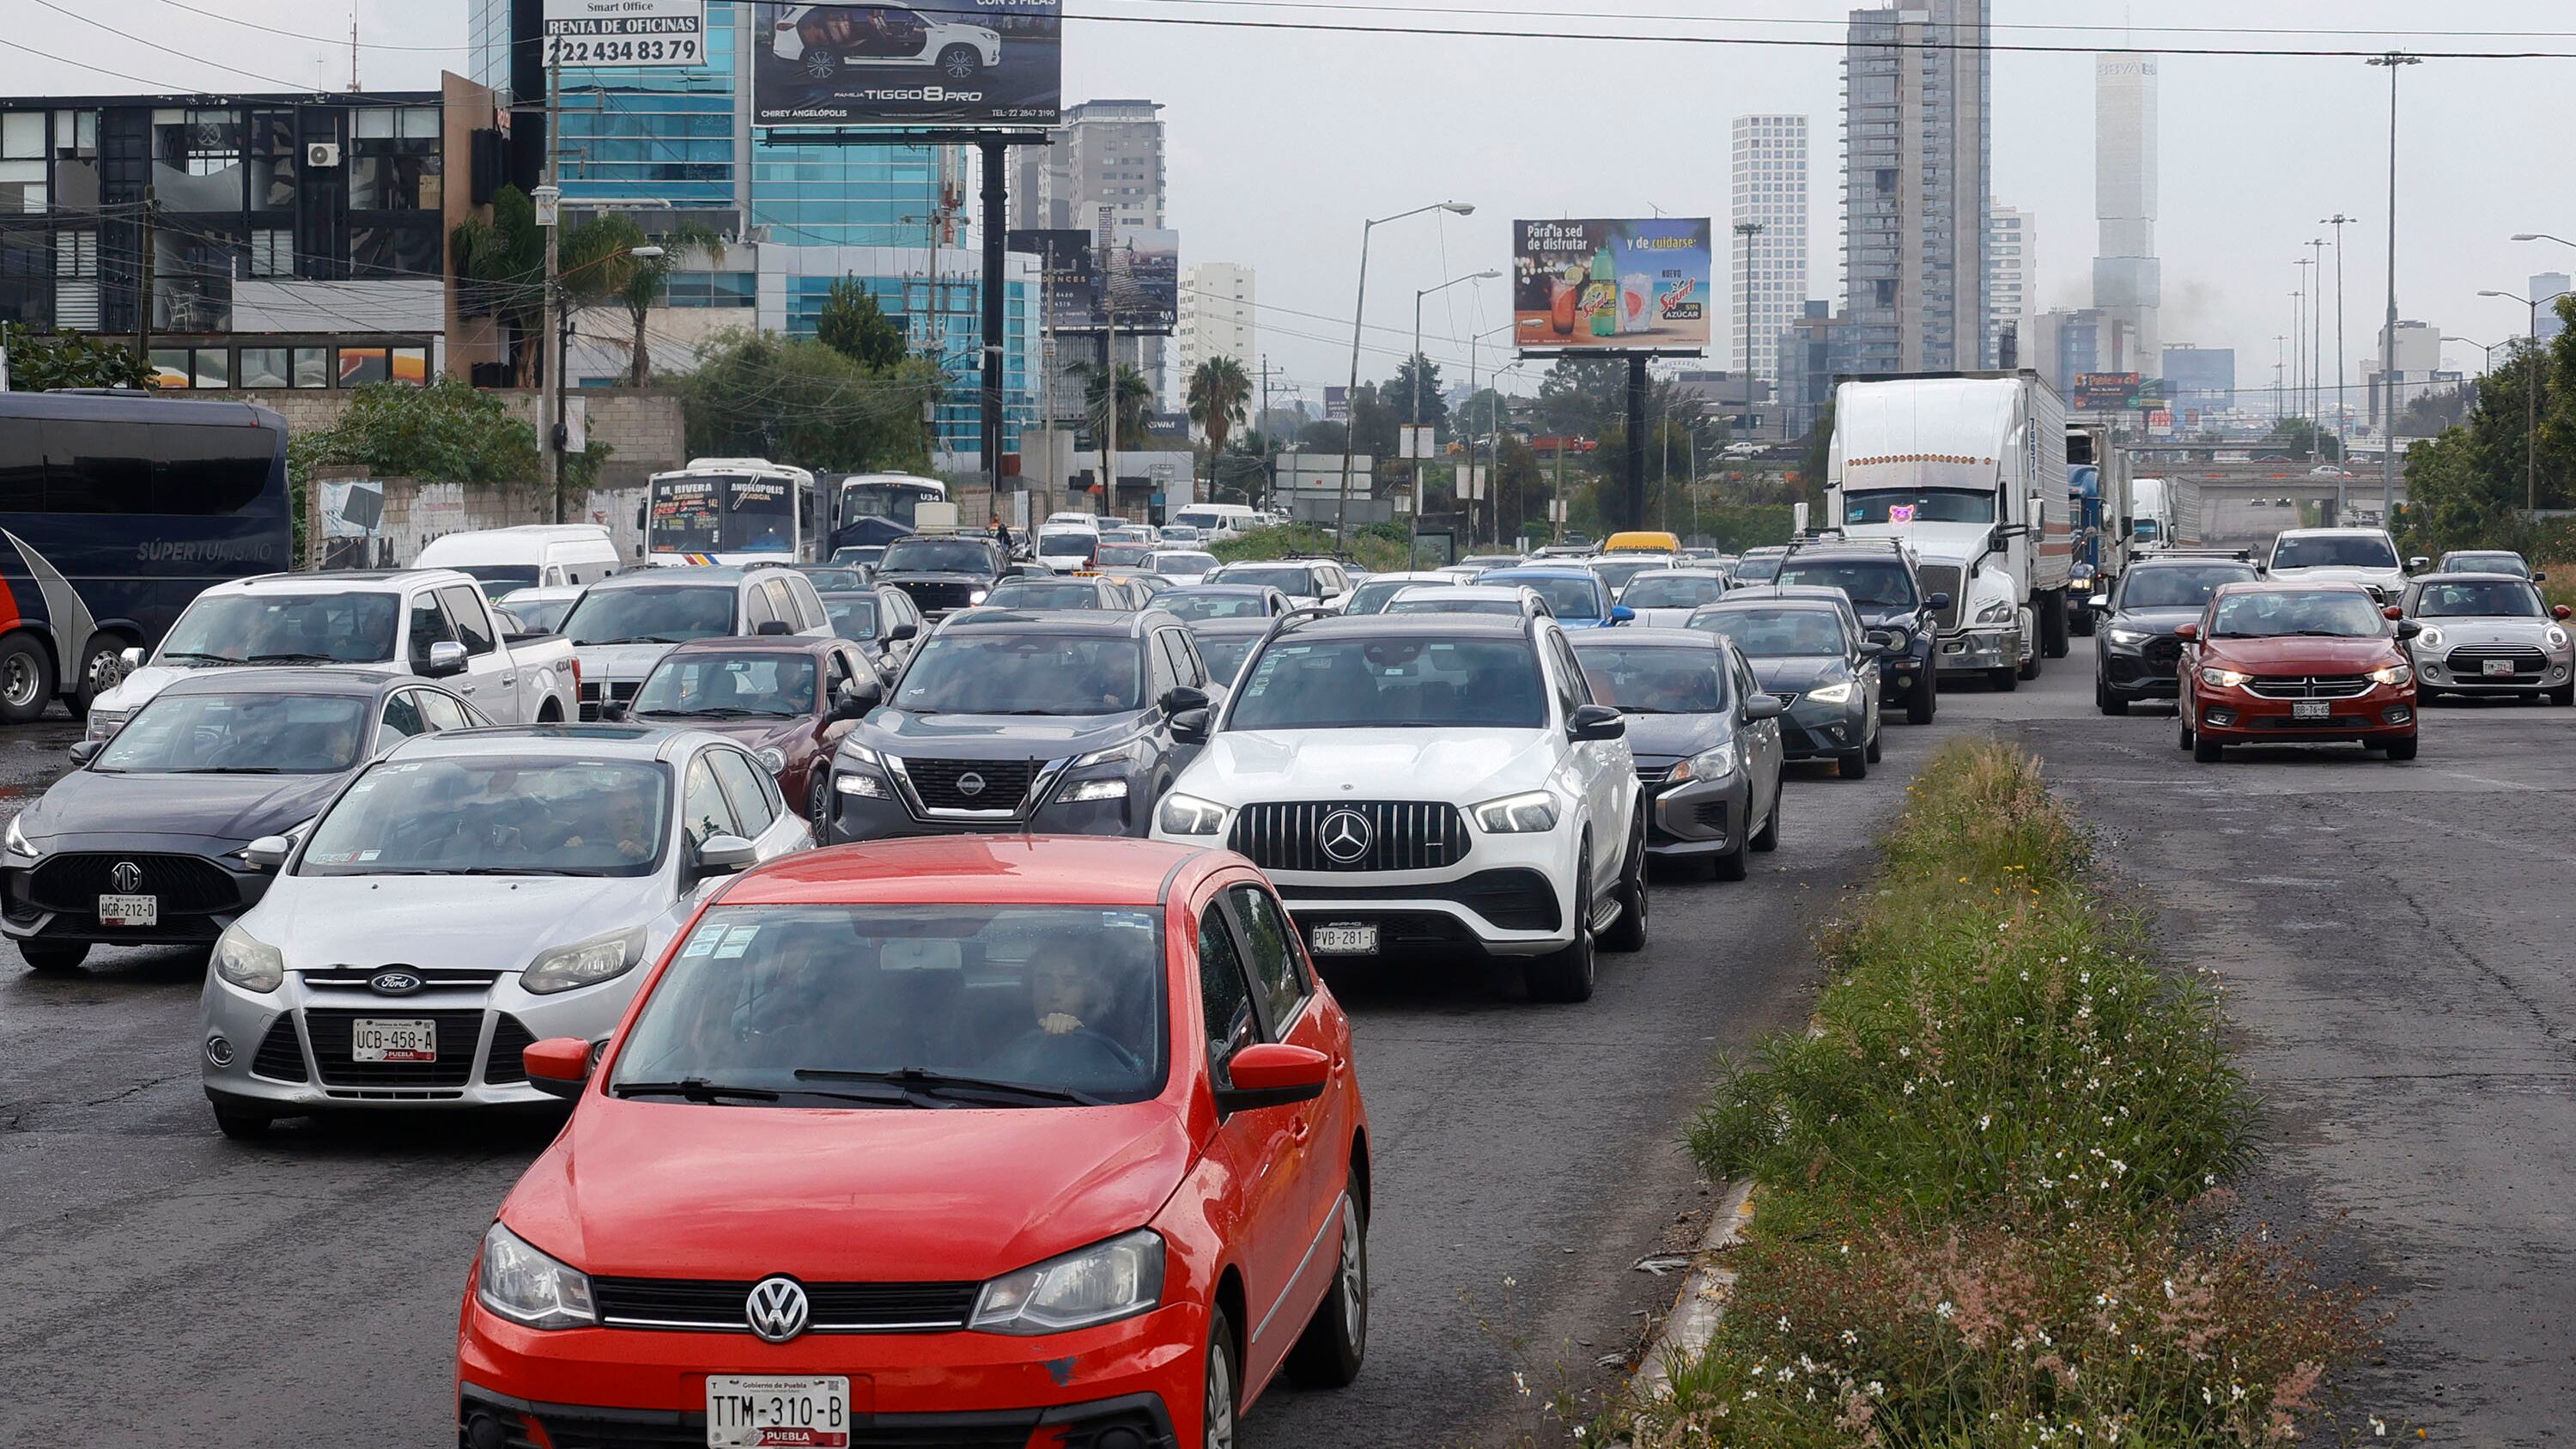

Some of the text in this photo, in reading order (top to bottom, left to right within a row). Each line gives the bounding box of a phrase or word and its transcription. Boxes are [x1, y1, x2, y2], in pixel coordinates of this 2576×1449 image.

[587, 1, 653, 12] Smart Office
[549, 18, 696, 34] RENTA DE OFICINAS
[549, 40, 696, 62] 222 434 83 79
[864, 89, 922, 100] TIGGO
[944, 92, 982, 101] PRO
[761, 108, 848, 118] CHIREY ANGELÓPOLIS
[1528, 225, 1583, 238] Para la sed
[1528, 238, 1588, 251] de disfrutar
[1627, 239, 1633, 251] y
[1636, 236, 1649, 248] de
[1660, 277, 1695, 314] Squirt
[1666, 309, 1699, 318] AZÚCAR
[660, 483, 713, 496] M. RIVERA
[731, 483, 784, 495] ANGELOPOLIS
[920, 492, 940, 502] U34
[114, 865, 138, 891] MG
[101, 903, 155, 917] HGR-212-D
[1314, 931, 1376, 946] PVB-281-D
[381, 976, 409, 988] Ford
[356, 1030, 433, 1050] UCB-458-A
[749, 1280, 806, 1340] VW
[713, 1396, 842, 1427] TTM-310-B
[767, 1432, 811, 1441] PUEBLA
